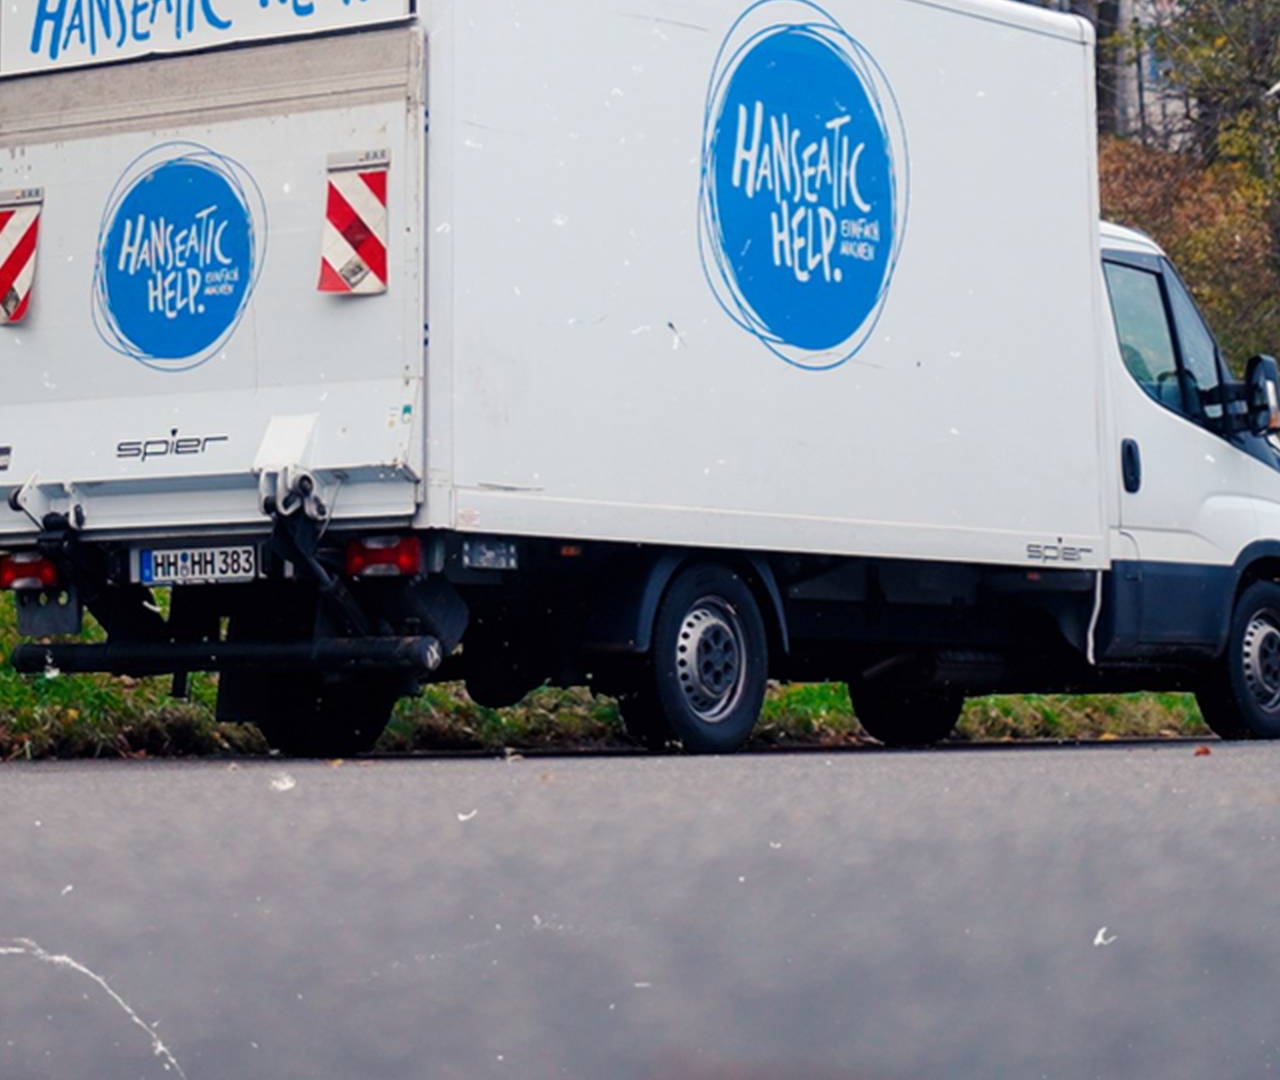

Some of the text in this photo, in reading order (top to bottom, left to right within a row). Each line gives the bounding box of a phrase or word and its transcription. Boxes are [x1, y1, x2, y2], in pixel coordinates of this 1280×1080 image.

[731, 100, 872, 213] HANSEATIC
[118, 205, 232, 275] HANSEATIC
[771, 200, 844, 283] HELP.
[148, 267, 206, 319] HELP.
[116, 428, 229, 463] spier
[1026, 536, 1092, 563] spier
